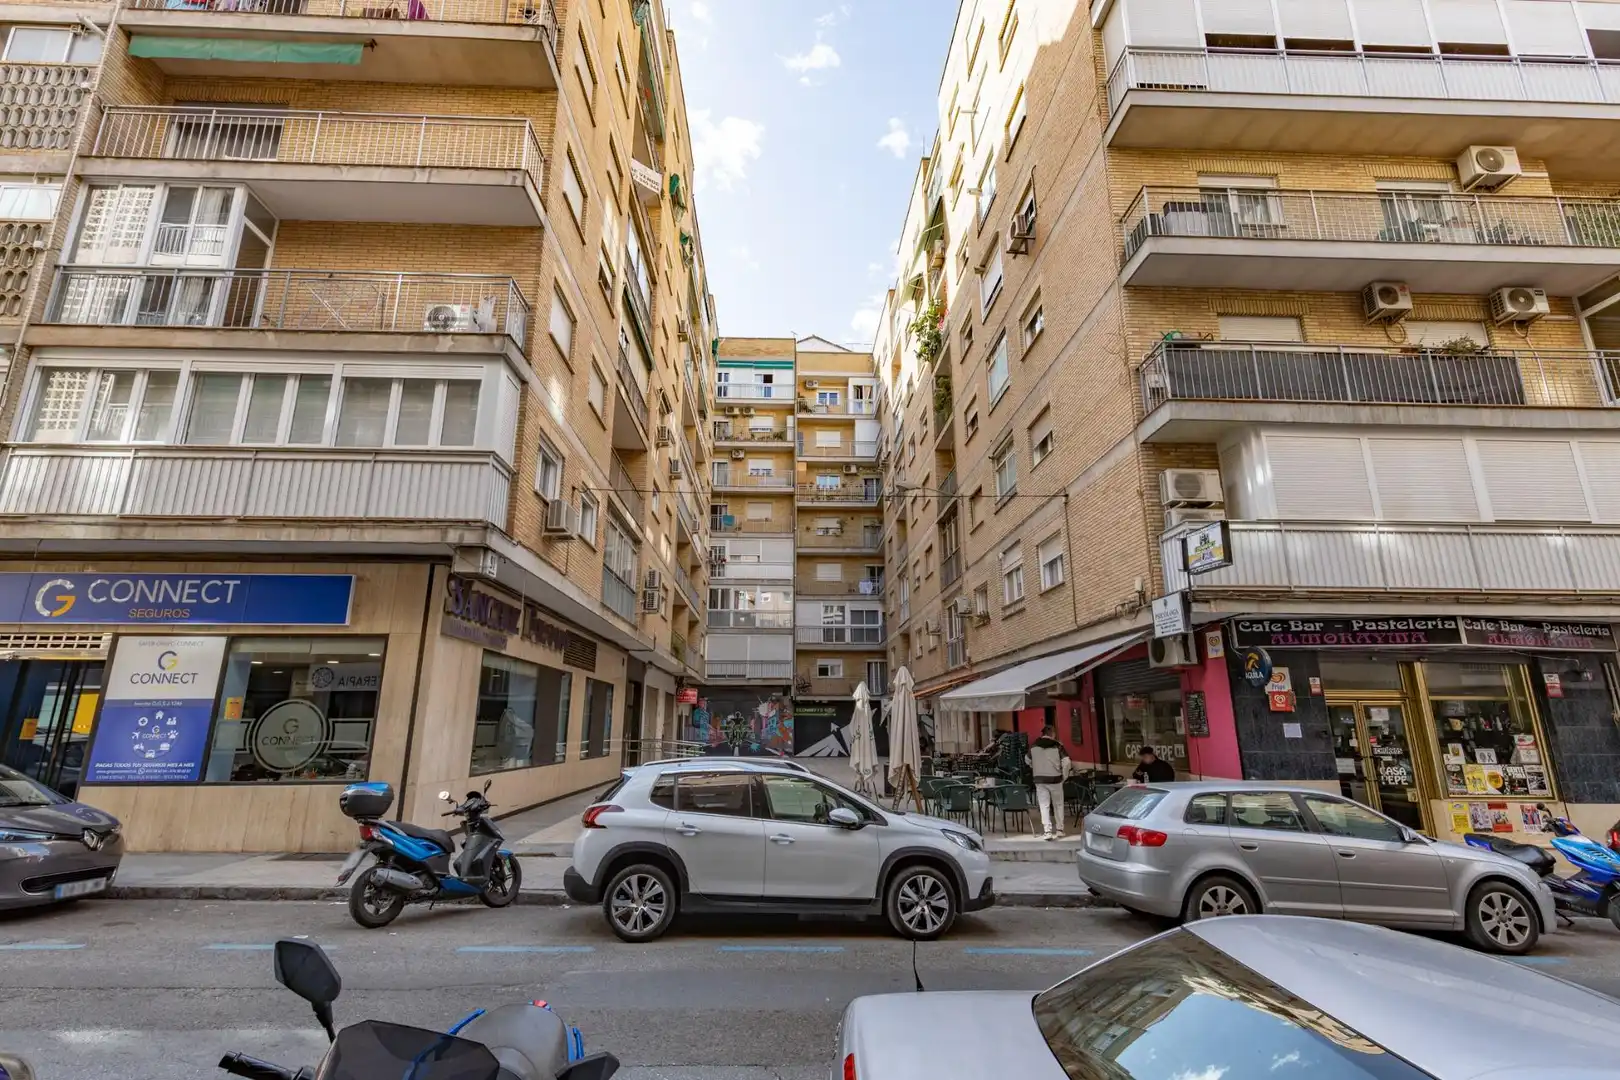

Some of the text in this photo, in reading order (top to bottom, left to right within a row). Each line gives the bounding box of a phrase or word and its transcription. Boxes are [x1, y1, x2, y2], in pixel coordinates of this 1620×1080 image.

[87, 578, 241, 604] CONNECT
[128, 608, 191, 619] SEGUROS
[130, 672, 198, 685] CONNECT
[261, 735, 316, 746] CONNECT
